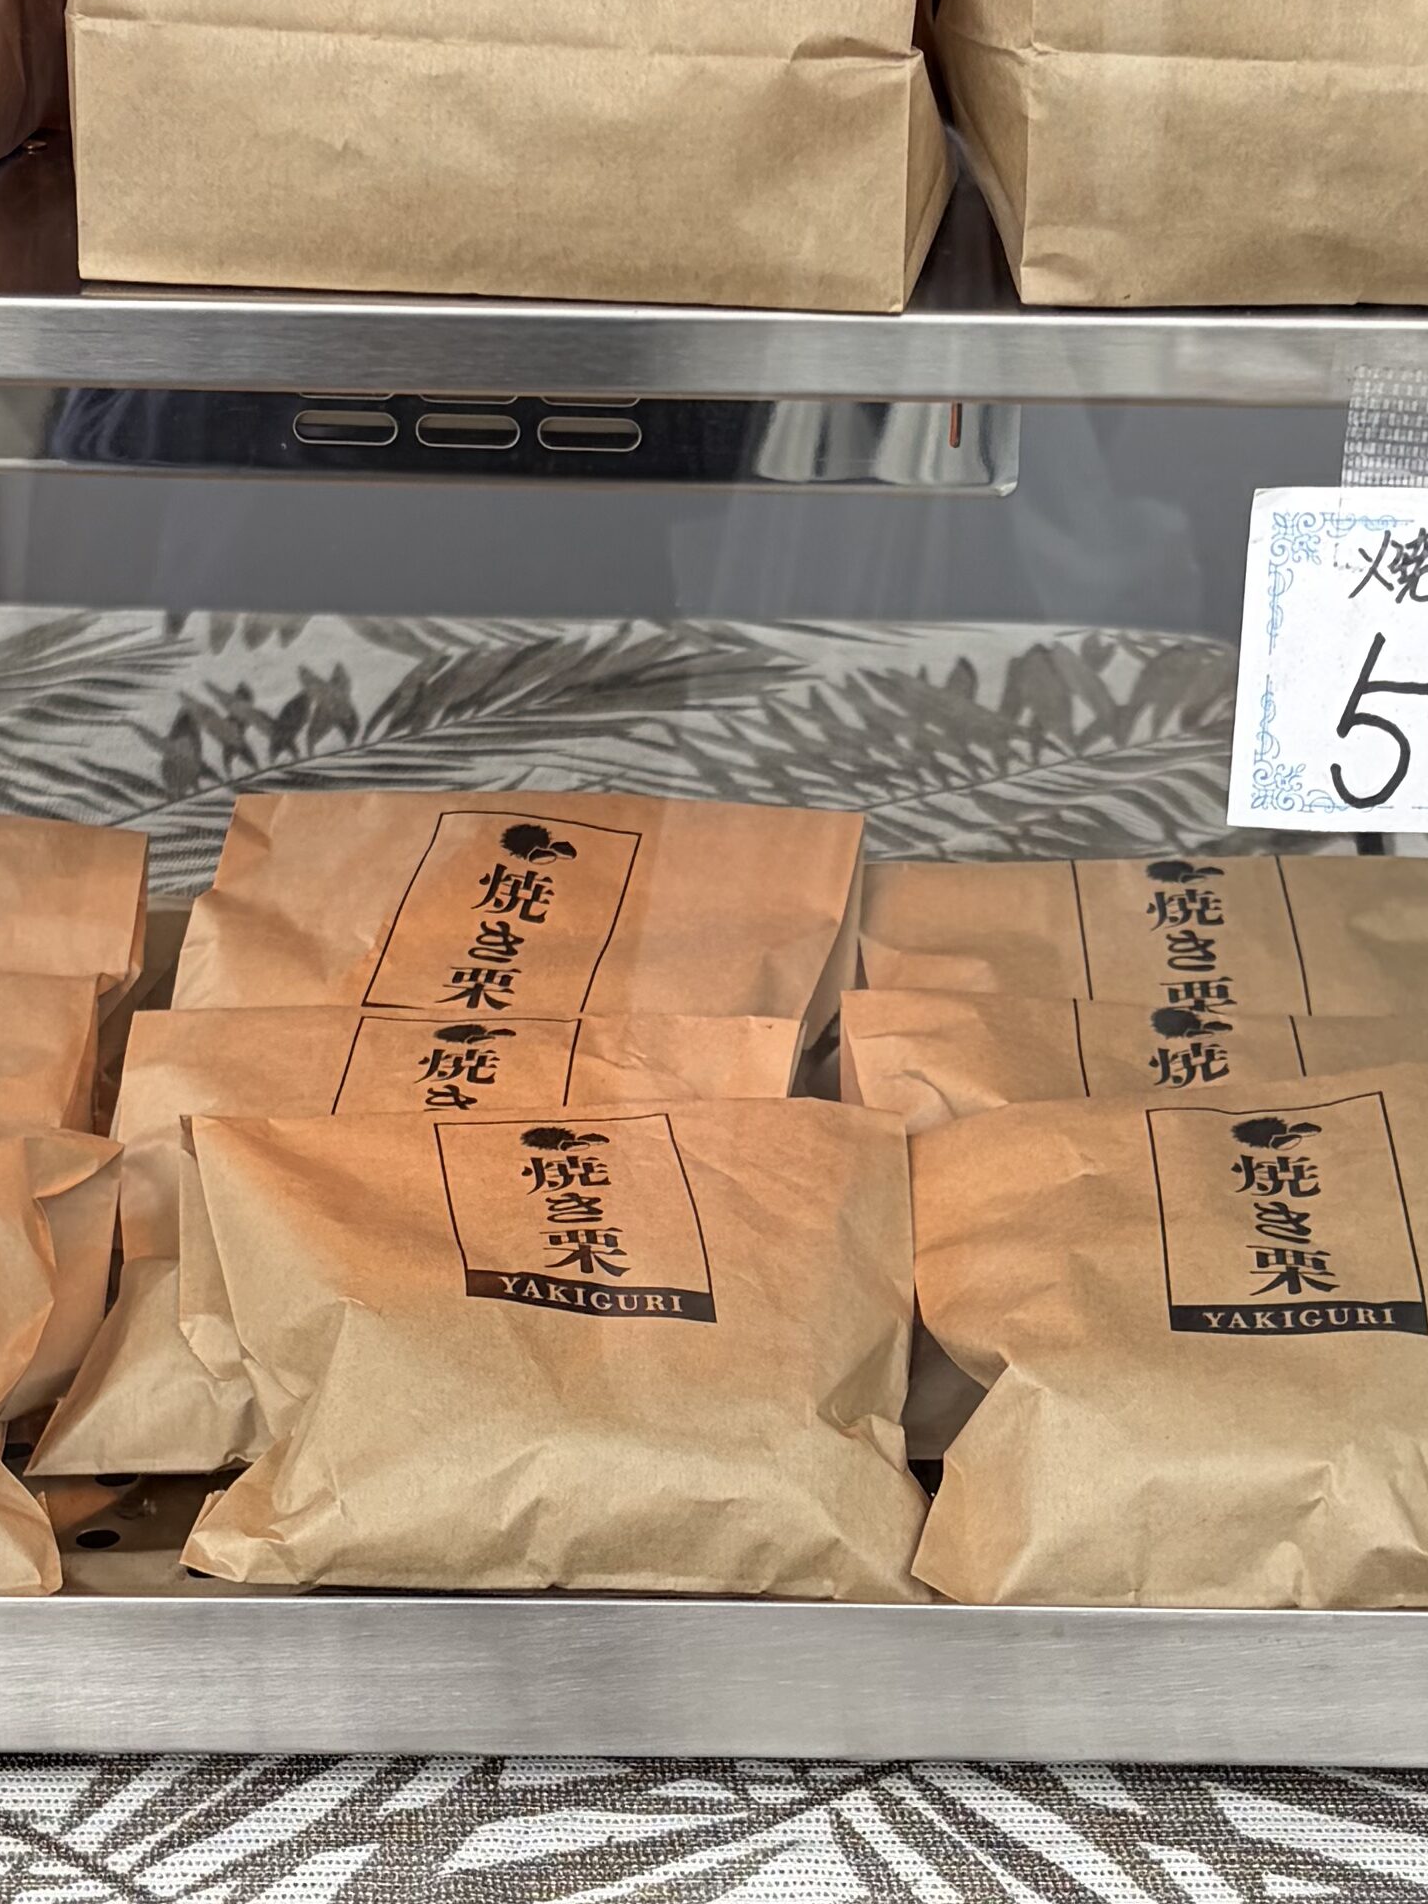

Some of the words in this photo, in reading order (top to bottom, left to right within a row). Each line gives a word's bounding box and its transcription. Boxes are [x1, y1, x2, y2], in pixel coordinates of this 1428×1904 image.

[434, 863, 555, 1011] 焼き栗
[1148, 1042, 1230, 1089] 焼
[521, 1154, 631, 1278] 焼き栗
[1230, 1154, 1341, 1296] 焼き栗
[495, 1274, 683, 1314] YAKIGURI
[1202, 1306, 1396, 1330] YAKIGURI
